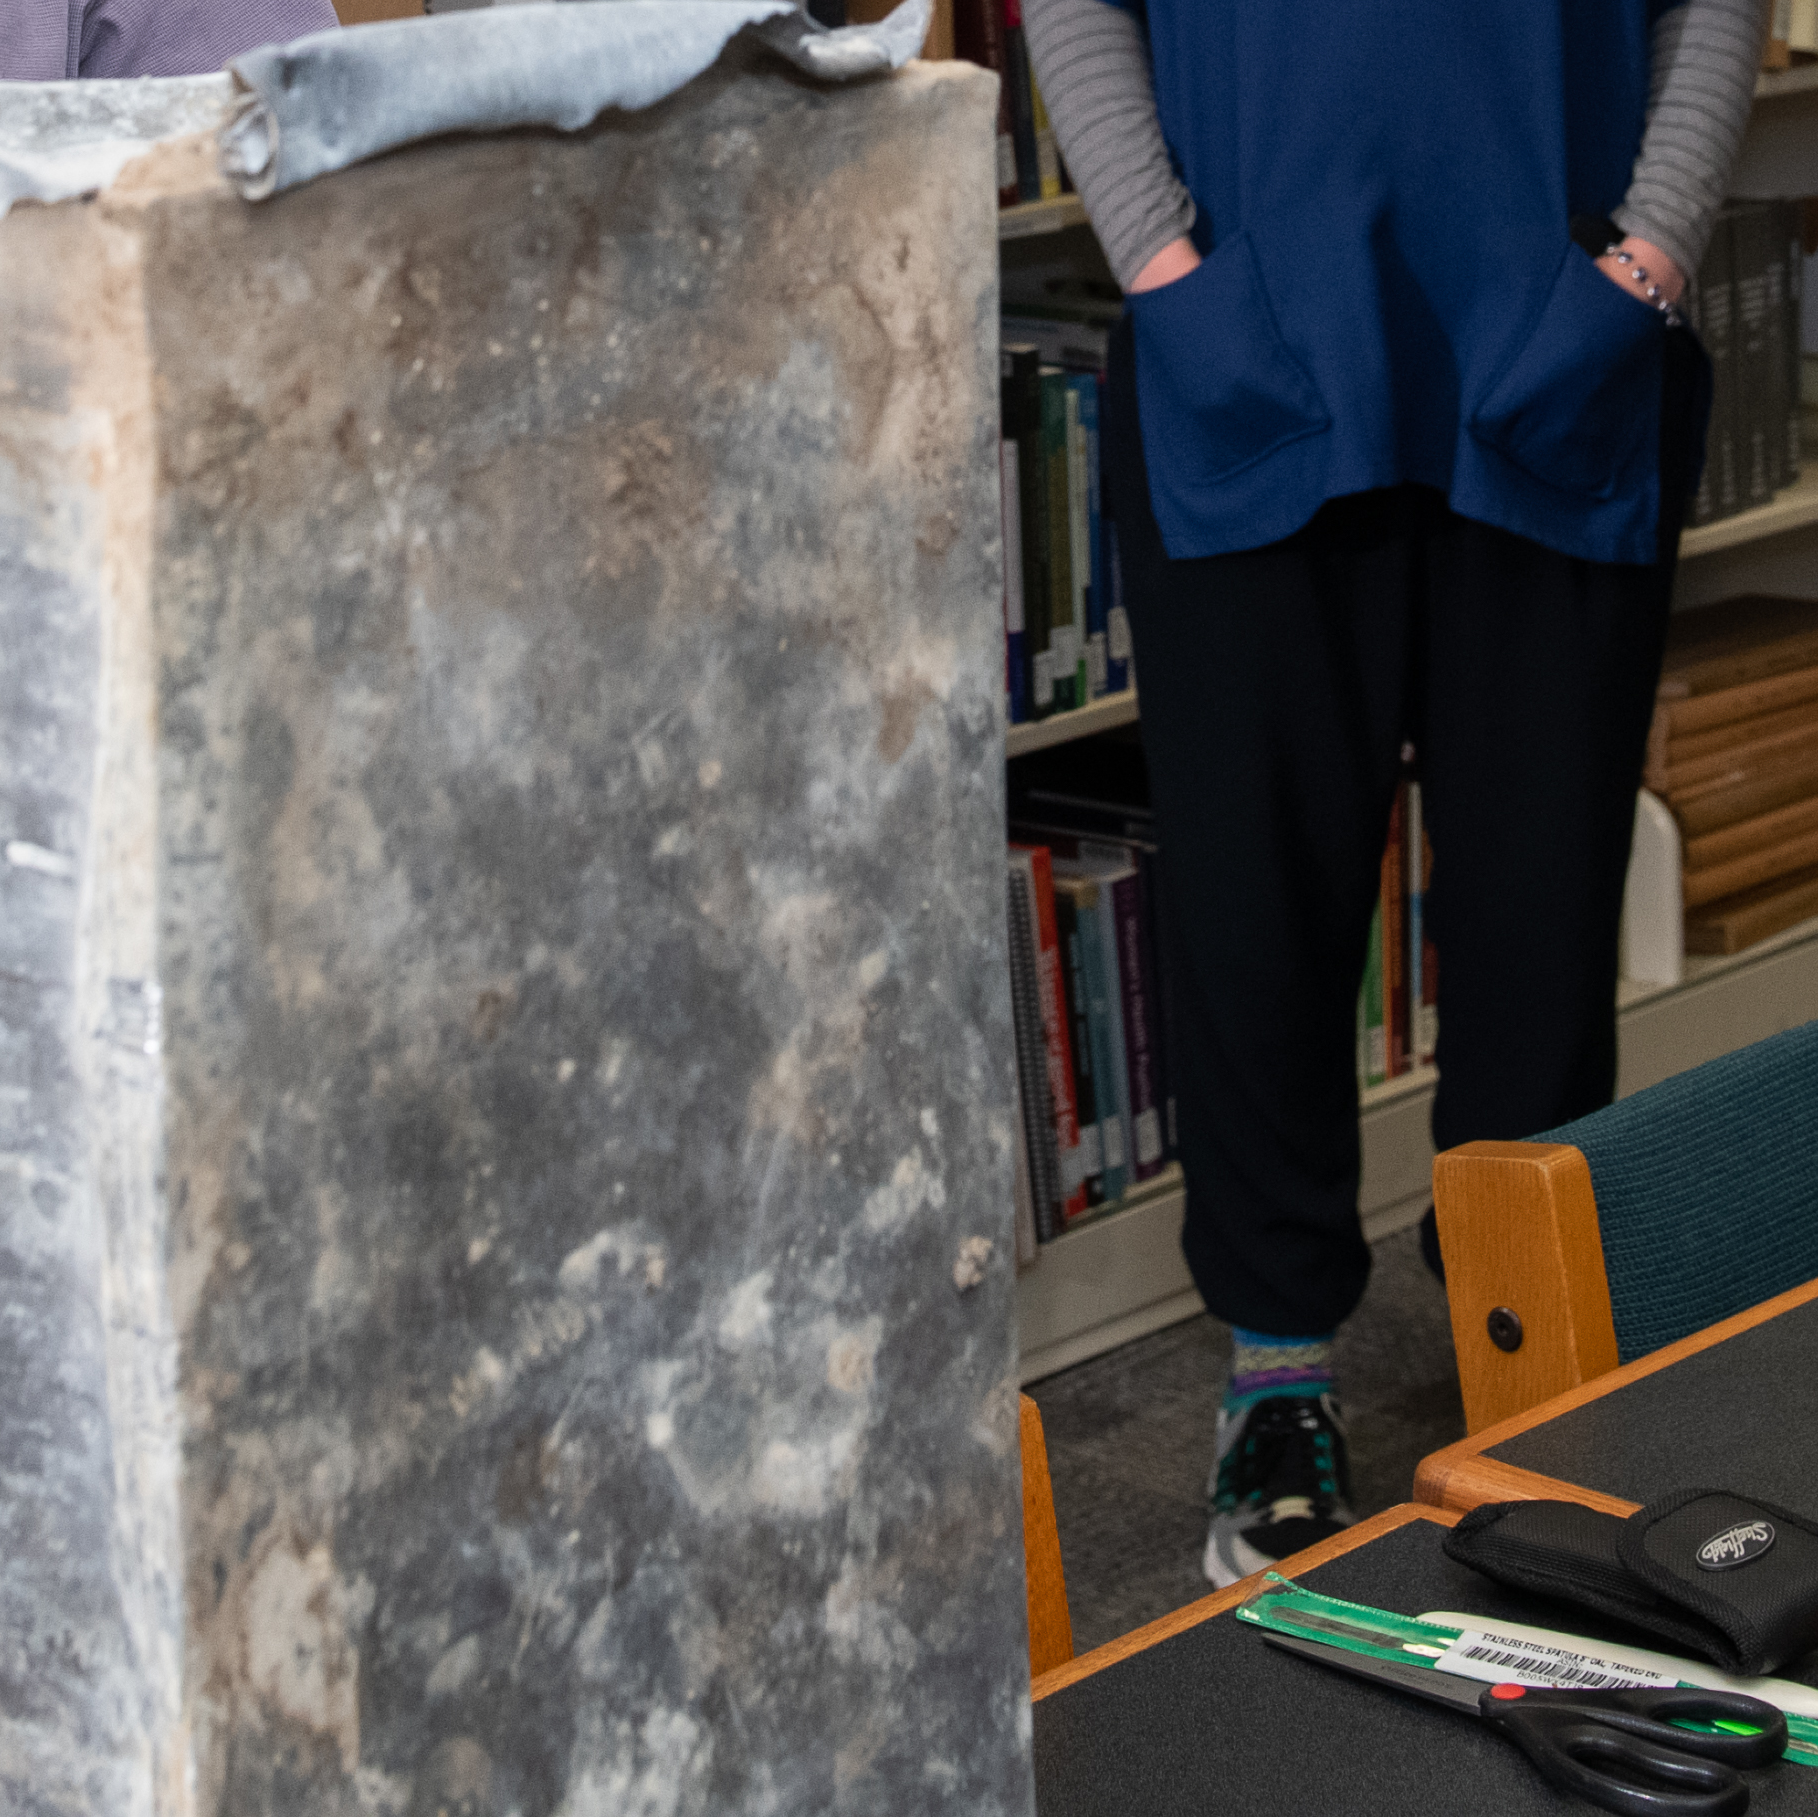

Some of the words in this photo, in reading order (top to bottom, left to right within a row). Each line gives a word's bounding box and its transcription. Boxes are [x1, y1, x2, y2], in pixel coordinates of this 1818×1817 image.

[1702, 1523, 1768, 1562] Sheffield
[1482, 1633, 1523, 1650] STAINLESS
[1524, 1642, 1545, 1655] STEEL
[1546, 1647, 1579, 1662] SPATULA
[1610, 1662, 1644, 1676] TAPERED
[1645, 1669, 1663, 1680] END
